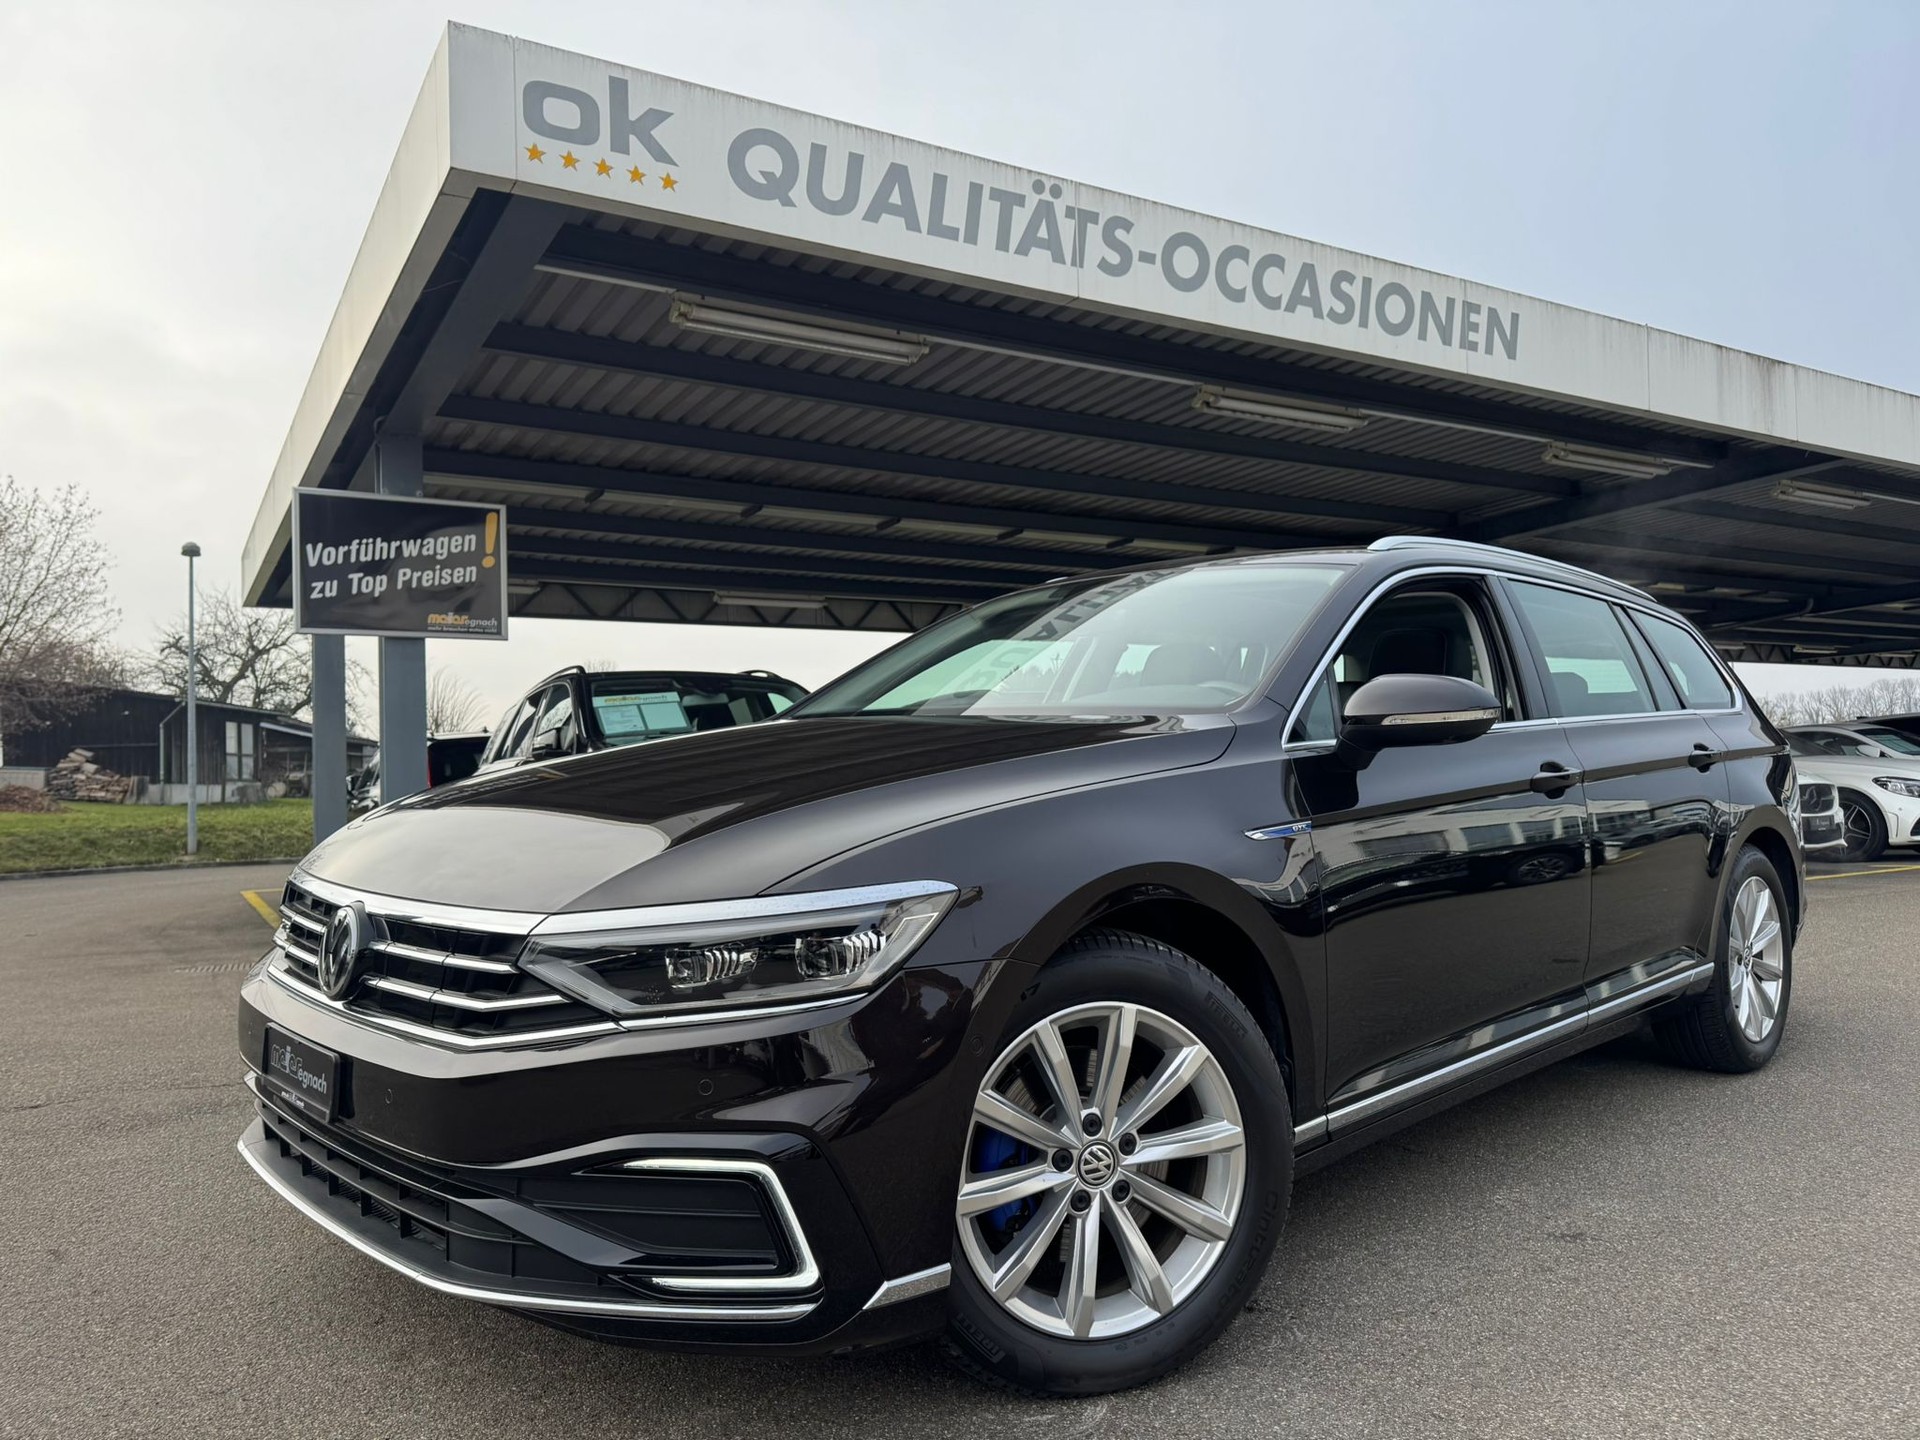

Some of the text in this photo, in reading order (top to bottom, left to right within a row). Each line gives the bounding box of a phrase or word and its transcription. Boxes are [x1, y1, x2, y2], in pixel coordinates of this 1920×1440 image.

[522, 75, 1521, 360] ok QUALITÄTS-OCCASIONEN
[306, 533, 477, 567] Vorführwagen
[310, 564, 477, 600] zu Top Preisen
